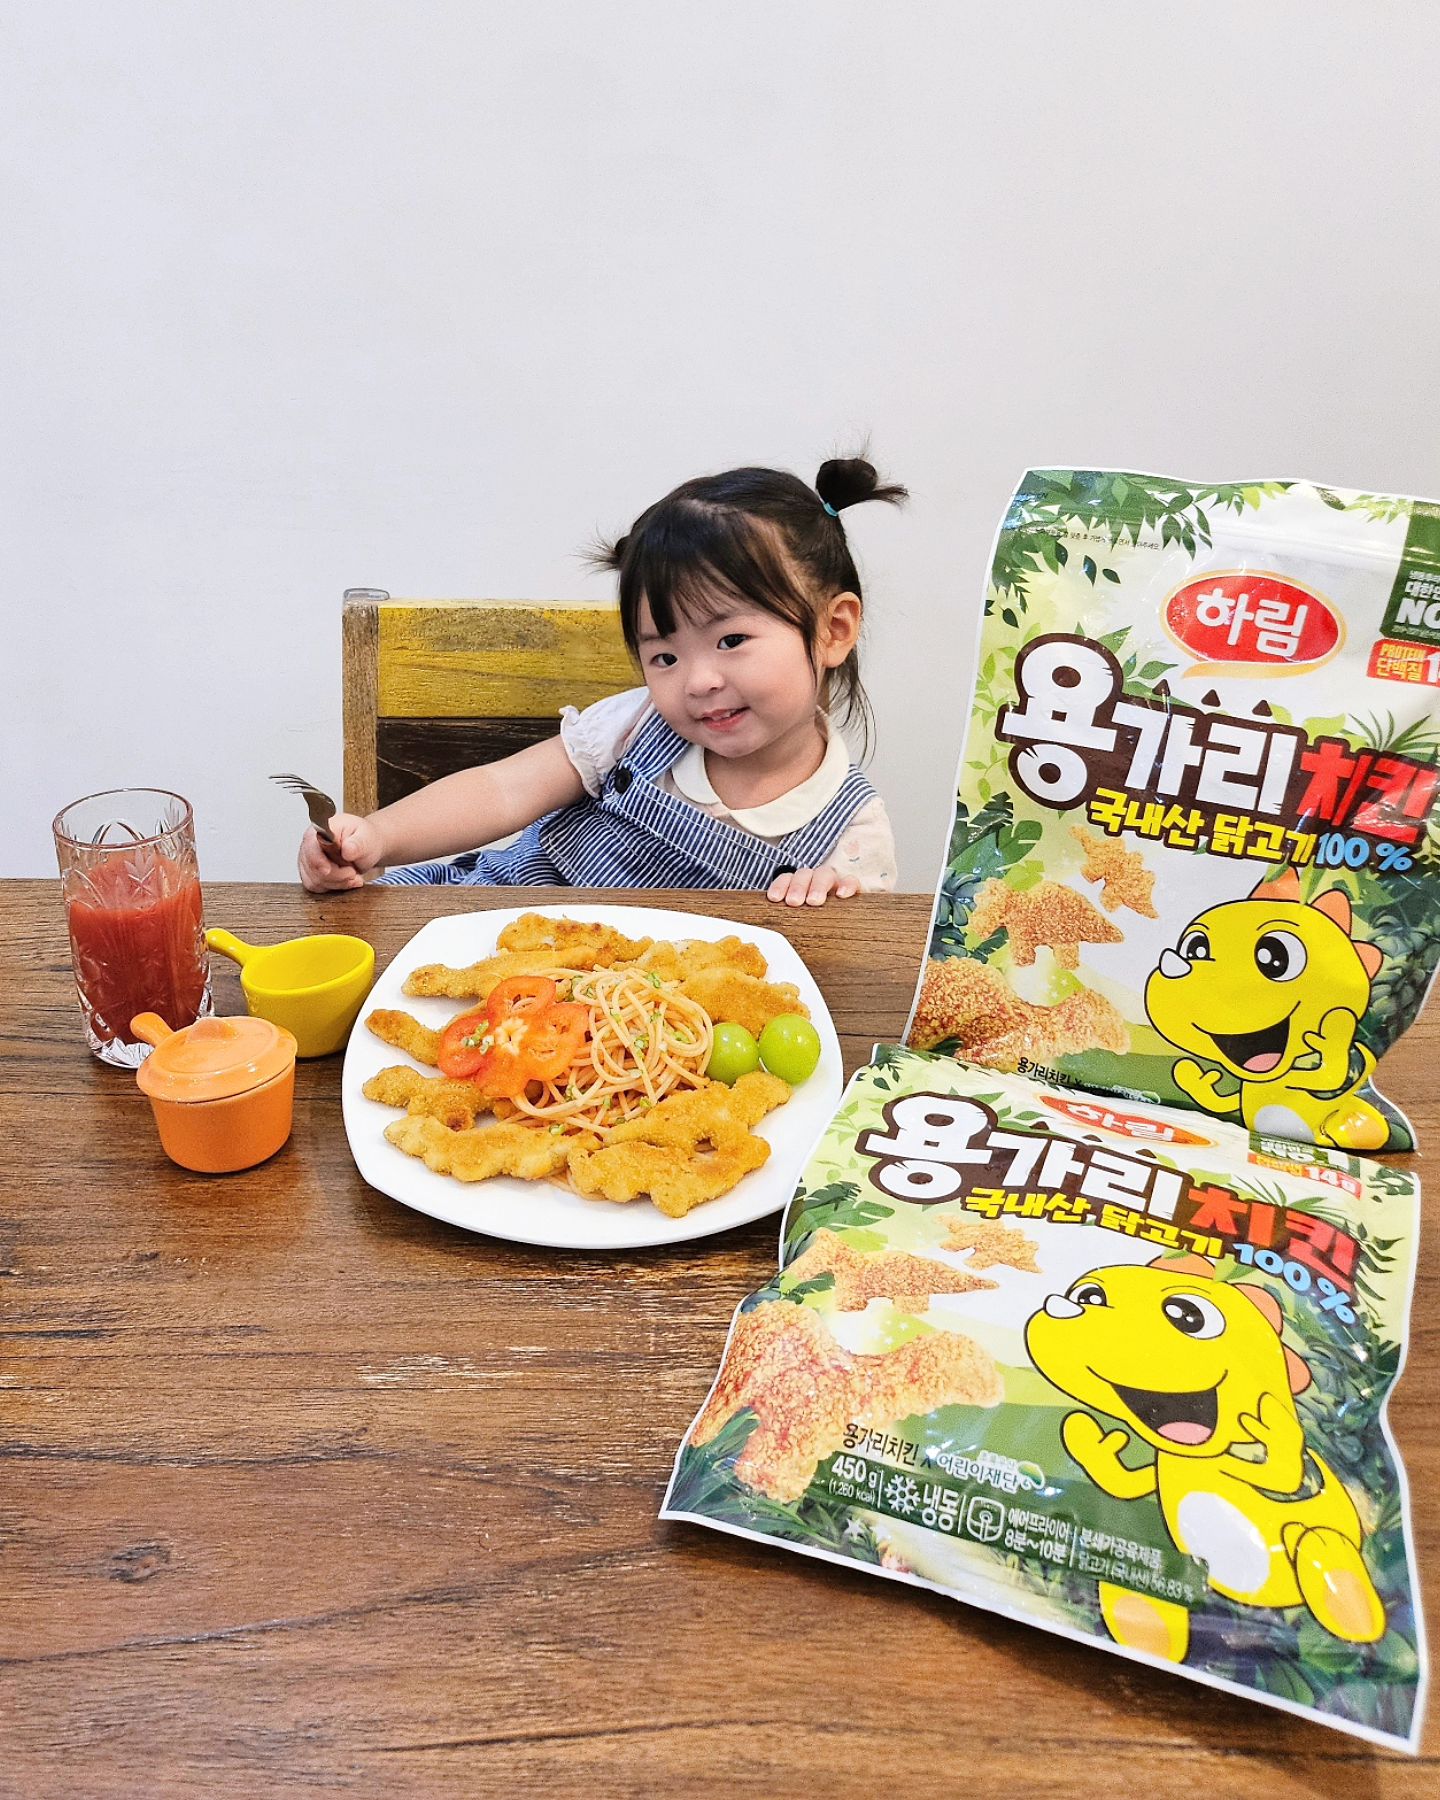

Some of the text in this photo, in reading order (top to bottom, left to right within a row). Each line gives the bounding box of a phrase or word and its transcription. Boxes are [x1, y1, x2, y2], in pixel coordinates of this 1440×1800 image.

[1196, 587, 1309, 659] 하림
[1376, 657, 1424, 682] 단백질
[1090, 787, 1206, 847] 국내산
[1212, 813, 1317, 865] 닭고기
[1017, 1056, 1071, 1085] 용가리치킨
[1067, 1102, 1175, 1143] 하림
[965, 1187, 1091, 1223] 국내산
[1100, 1205, 1224, 1259] 닭고기
[831, 1454, 867, 1483] 450
[843, 1422, 920, 1468] 용가리치킨
[937, 1452, 1019, 1494] 어린이재단
[921, 1482, 960, 1532] 냉동
[1008, 1507, 1071, 1543] 에어프라이어
[1079, 1526, 1163, 1571] 분쇄가공육제품
